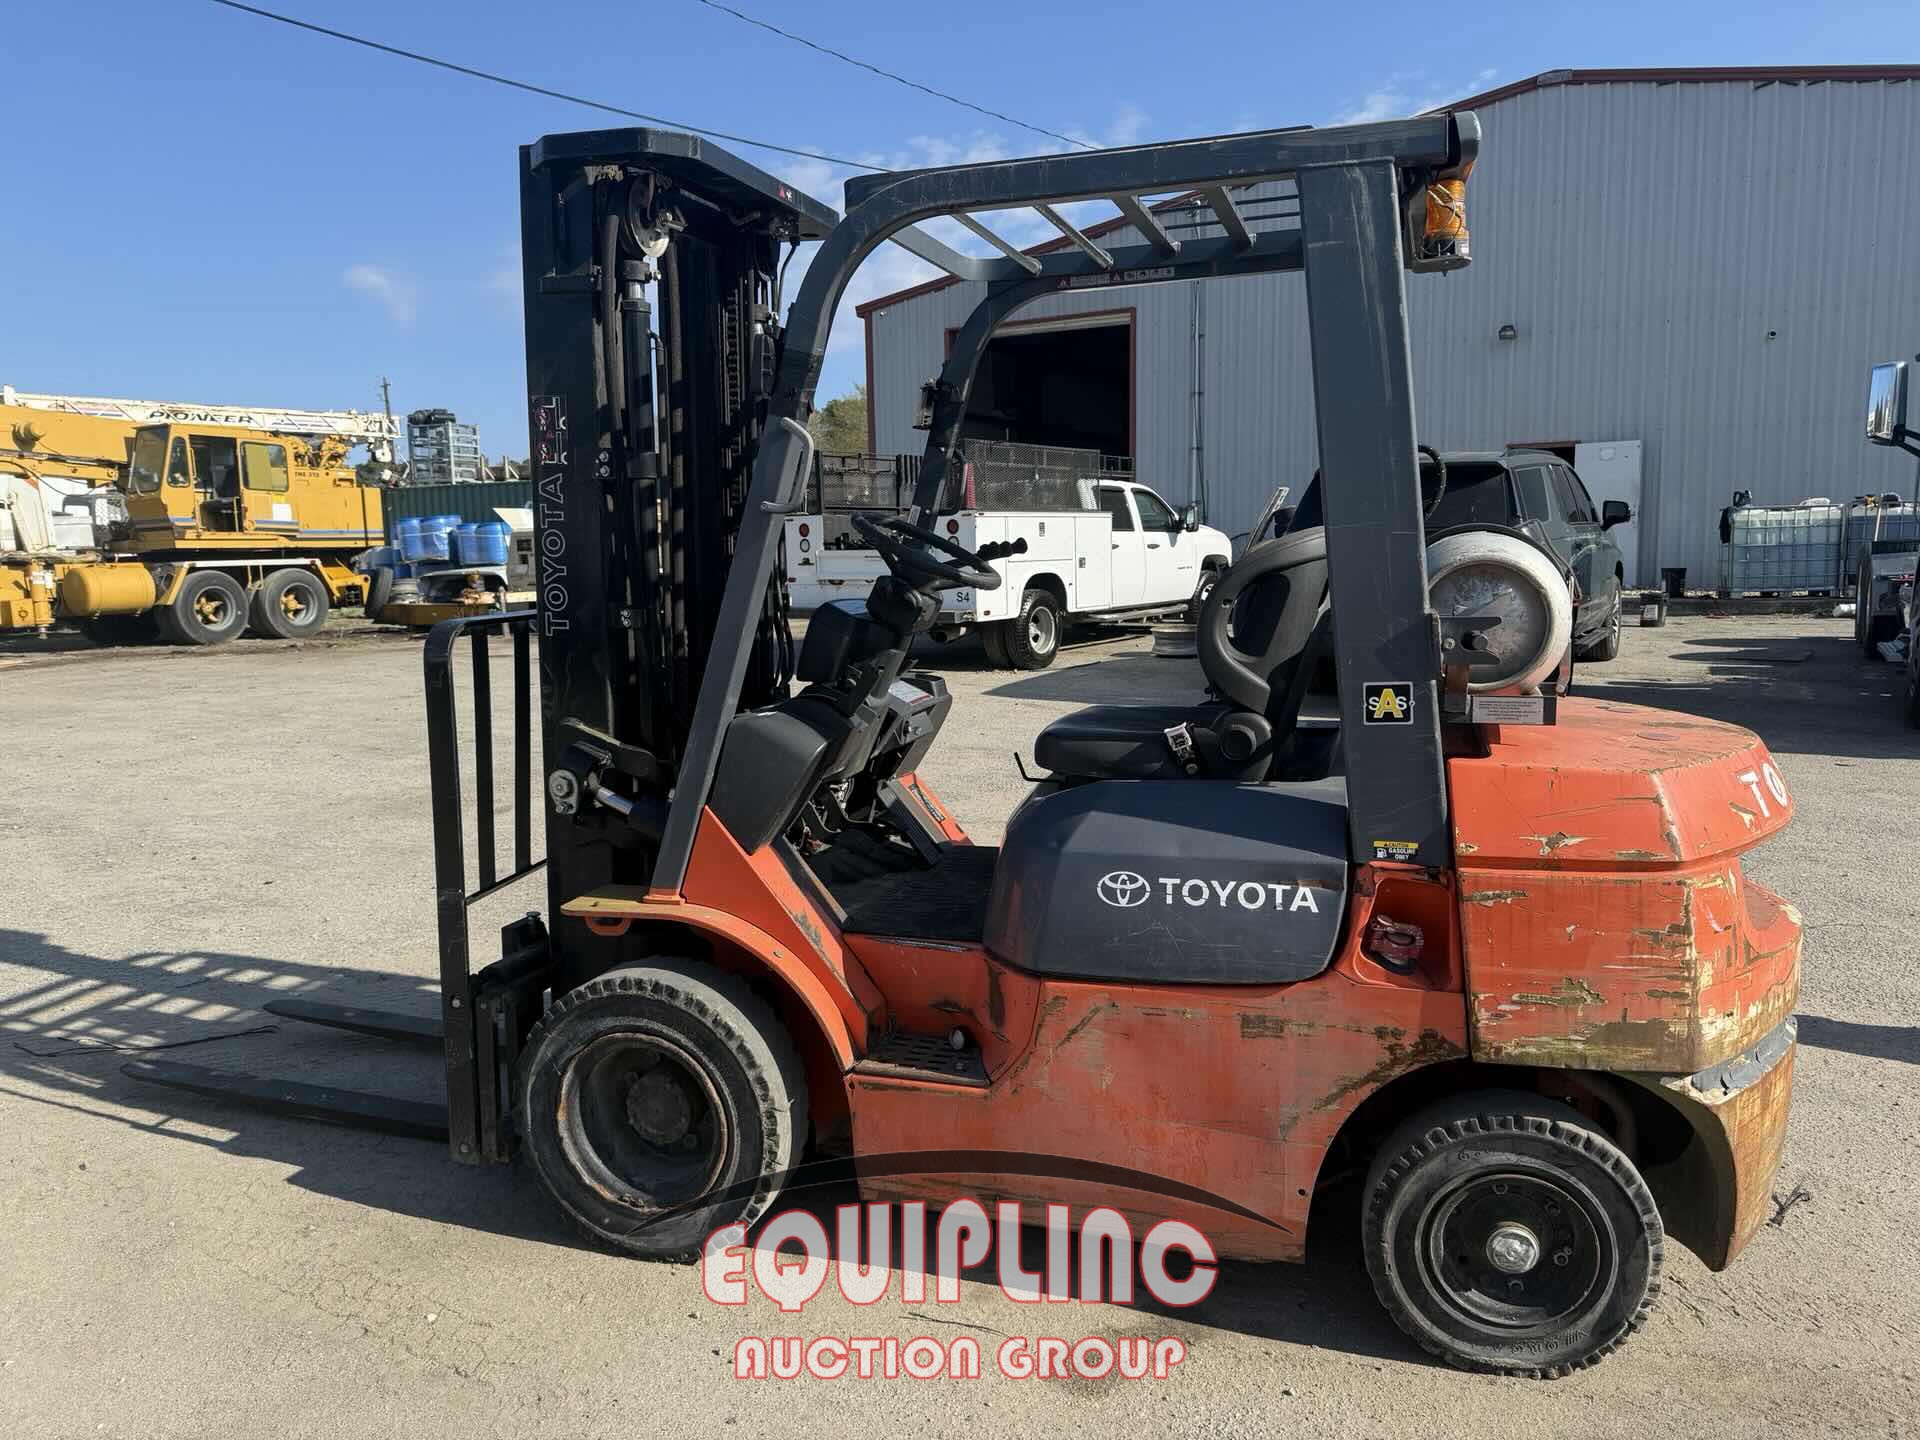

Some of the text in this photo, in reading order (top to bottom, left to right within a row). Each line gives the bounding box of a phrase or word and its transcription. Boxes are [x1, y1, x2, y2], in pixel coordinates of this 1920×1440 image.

[149, 410, 254, 424] PIONEER
[538, 472, 570, 637] TOYOTA
[955, 591, 970, 602] S4
[1368, 688, 1408, 718] SAS
[1158, 877, 1319, 913] TOYOTA
